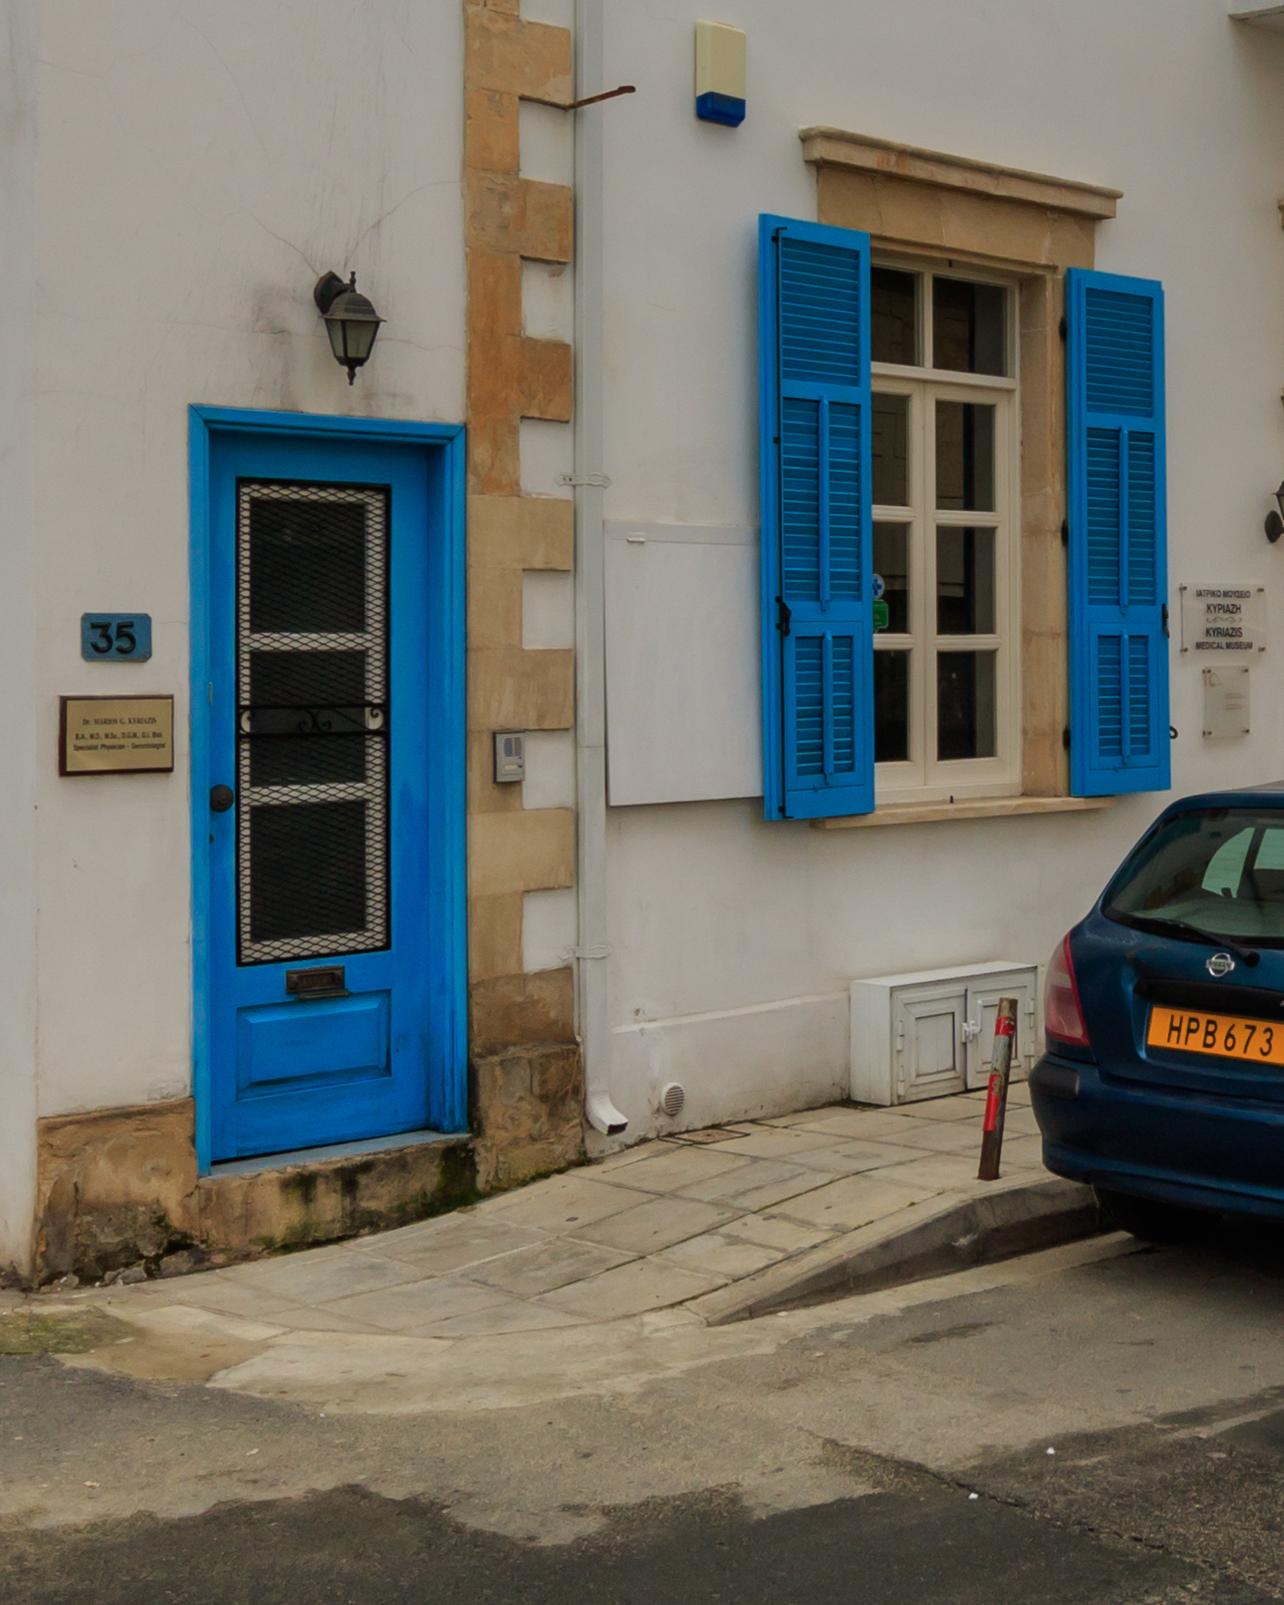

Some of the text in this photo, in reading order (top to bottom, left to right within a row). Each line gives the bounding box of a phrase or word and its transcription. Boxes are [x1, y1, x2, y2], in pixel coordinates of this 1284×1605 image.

[1196, 589, 1222, 598] ΙΑΤΡΙΚΟ
[1206, 603, 1242, 614] ΚΥΡΙΑΖΗ
[90, 621, 137, 655] 35
[1205, 627, 1243, 638] KYRIAZIS
[1196, 641, 1253, 650] MEDICAL MUSEUM
